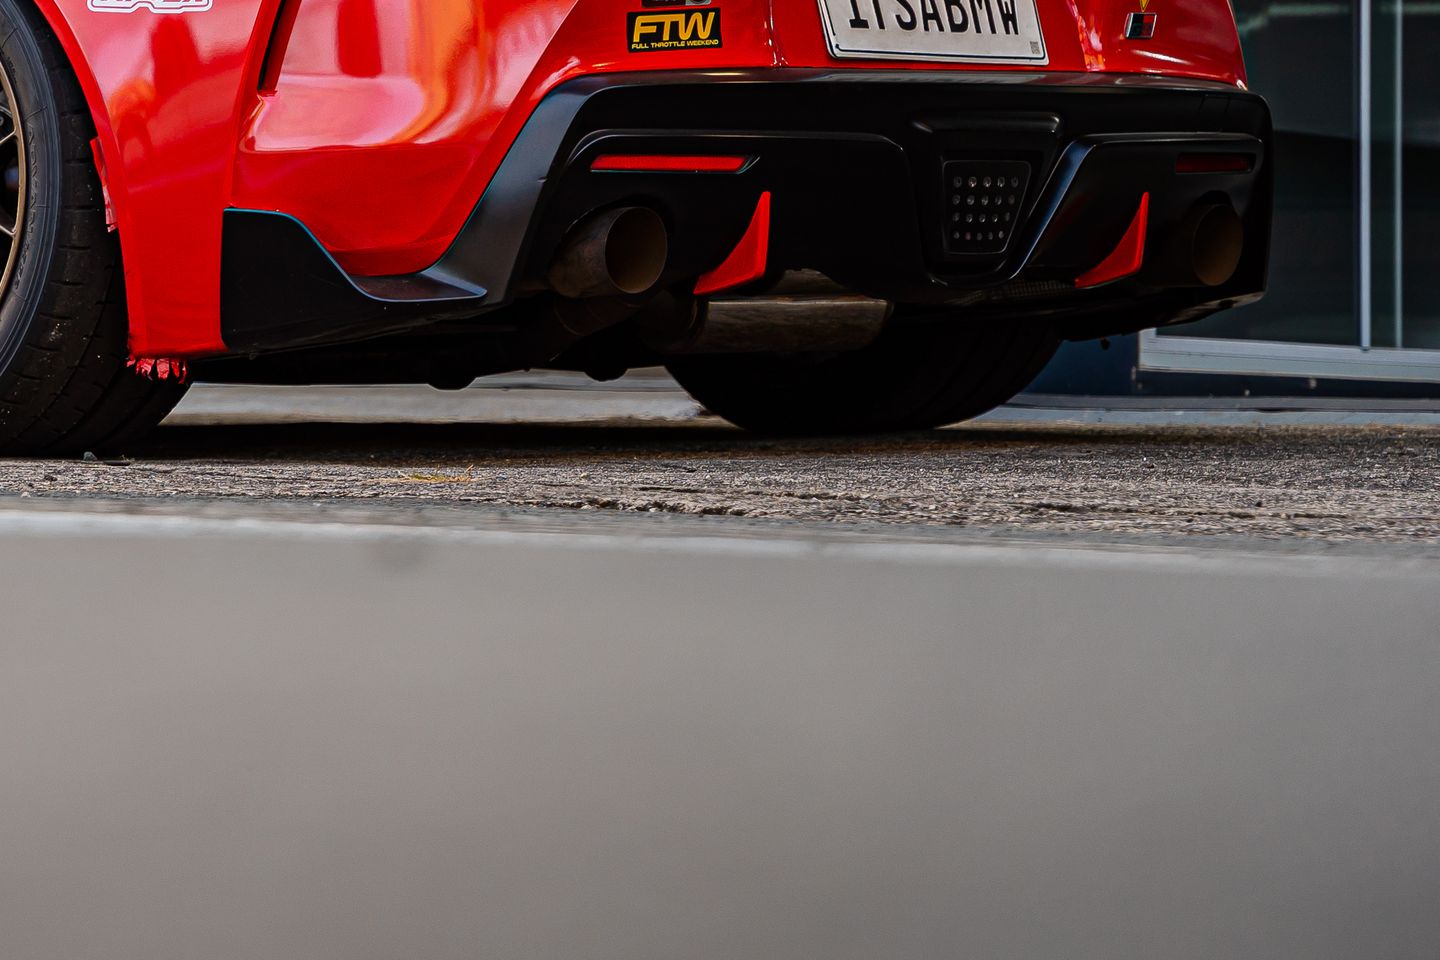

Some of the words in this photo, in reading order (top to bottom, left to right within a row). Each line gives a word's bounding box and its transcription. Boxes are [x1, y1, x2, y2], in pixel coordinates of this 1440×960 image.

[633, 11, 716, 43] FTW
[650, 41, 686, 49] THROTTLE
[687, 39, 719, 47] WEEKEND
